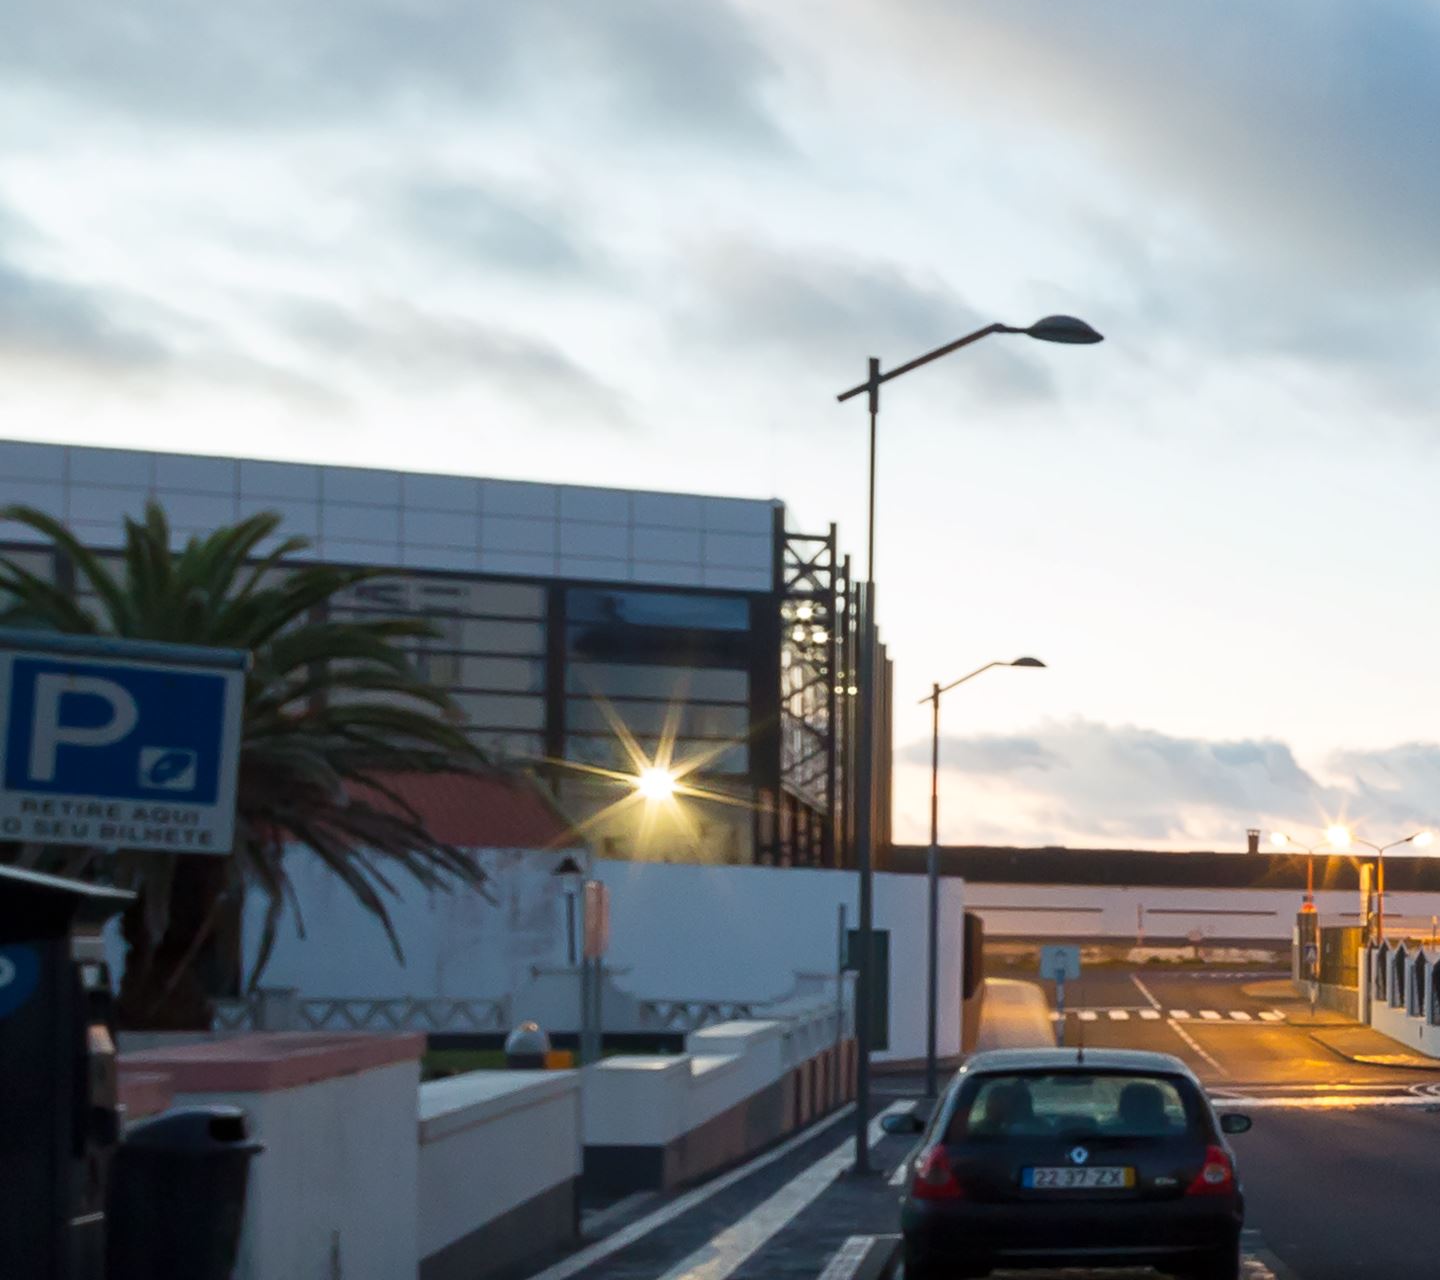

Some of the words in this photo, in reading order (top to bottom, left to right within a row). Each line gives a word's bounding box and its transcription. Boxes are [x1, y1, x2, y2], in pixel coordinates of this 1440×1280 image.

[27, 672, 138, 782] P
[21, 797, 120, 820] RETIRE
[133, 806, 200, 825] AQUI
[3, 815, 22, 835] O
[34, 819, 89, 839] SEU
[100, 823, 213, 845] BILHETE
